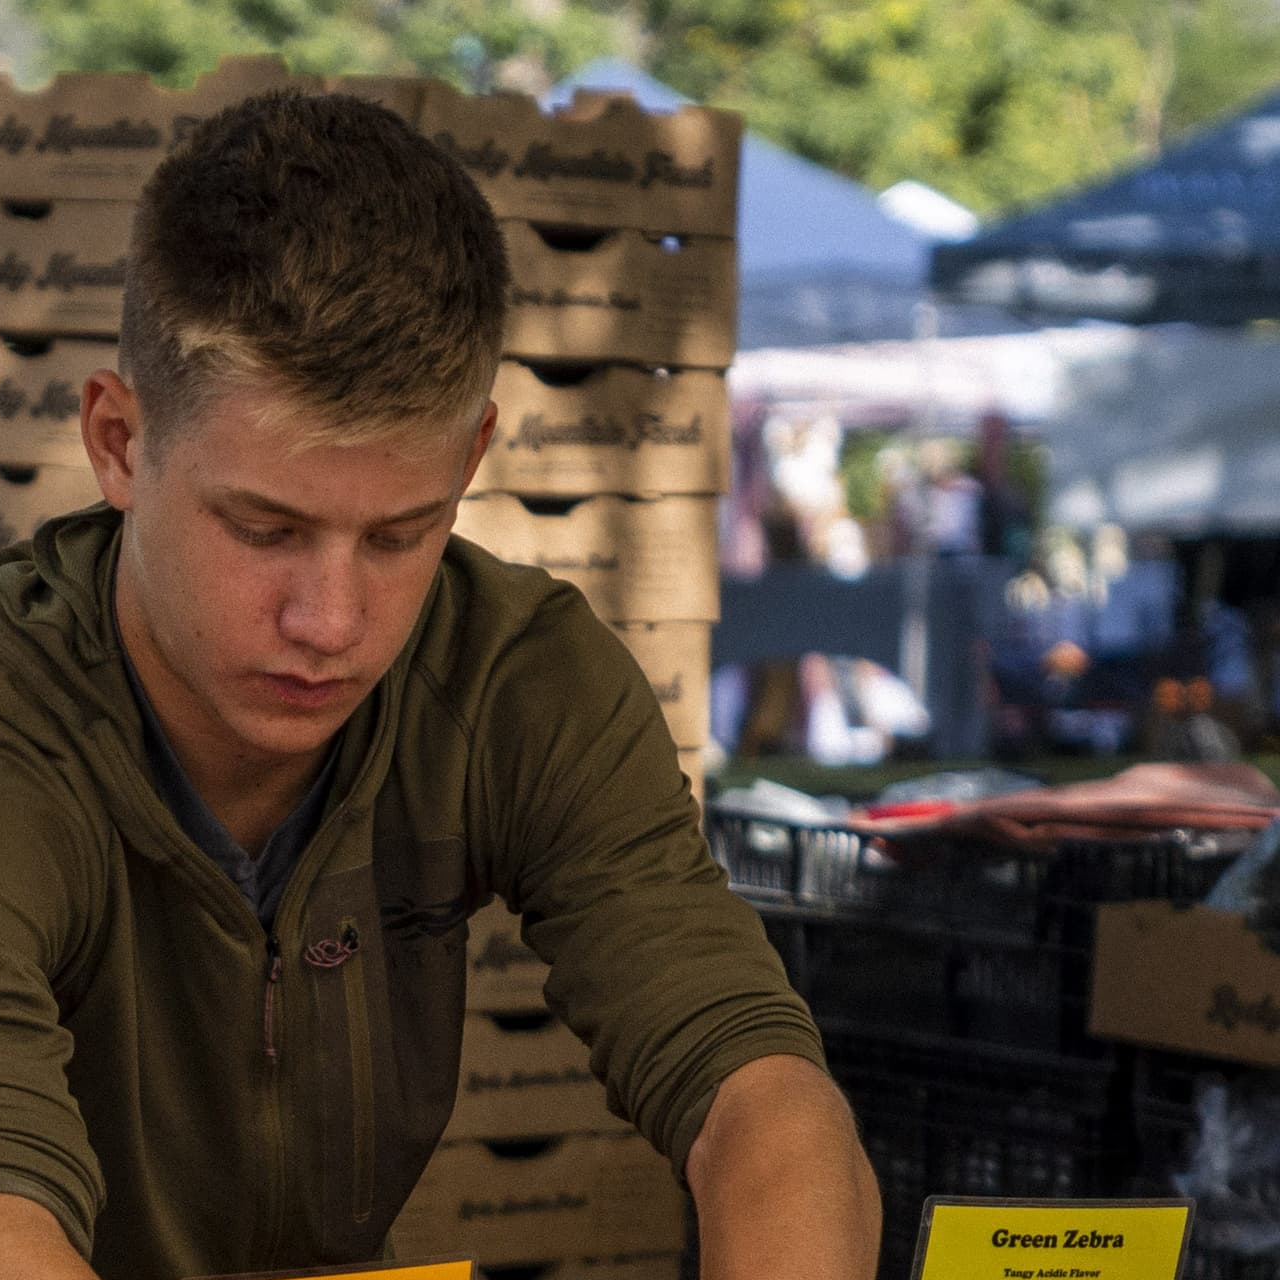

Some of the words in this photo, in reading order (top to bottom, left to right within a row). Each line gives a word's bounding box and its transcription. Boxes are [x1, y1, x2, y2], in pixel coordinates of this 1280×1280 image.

[991, 1229, 1058, 1249] Green
[1062, 1230, 1124, 1249] Zebra
[1003, 1268, 1034, 1280] Tangy
[1036, 1268, 1068, 1279] Acidic
[1069, 1268, 1101, 1279] Flavor
